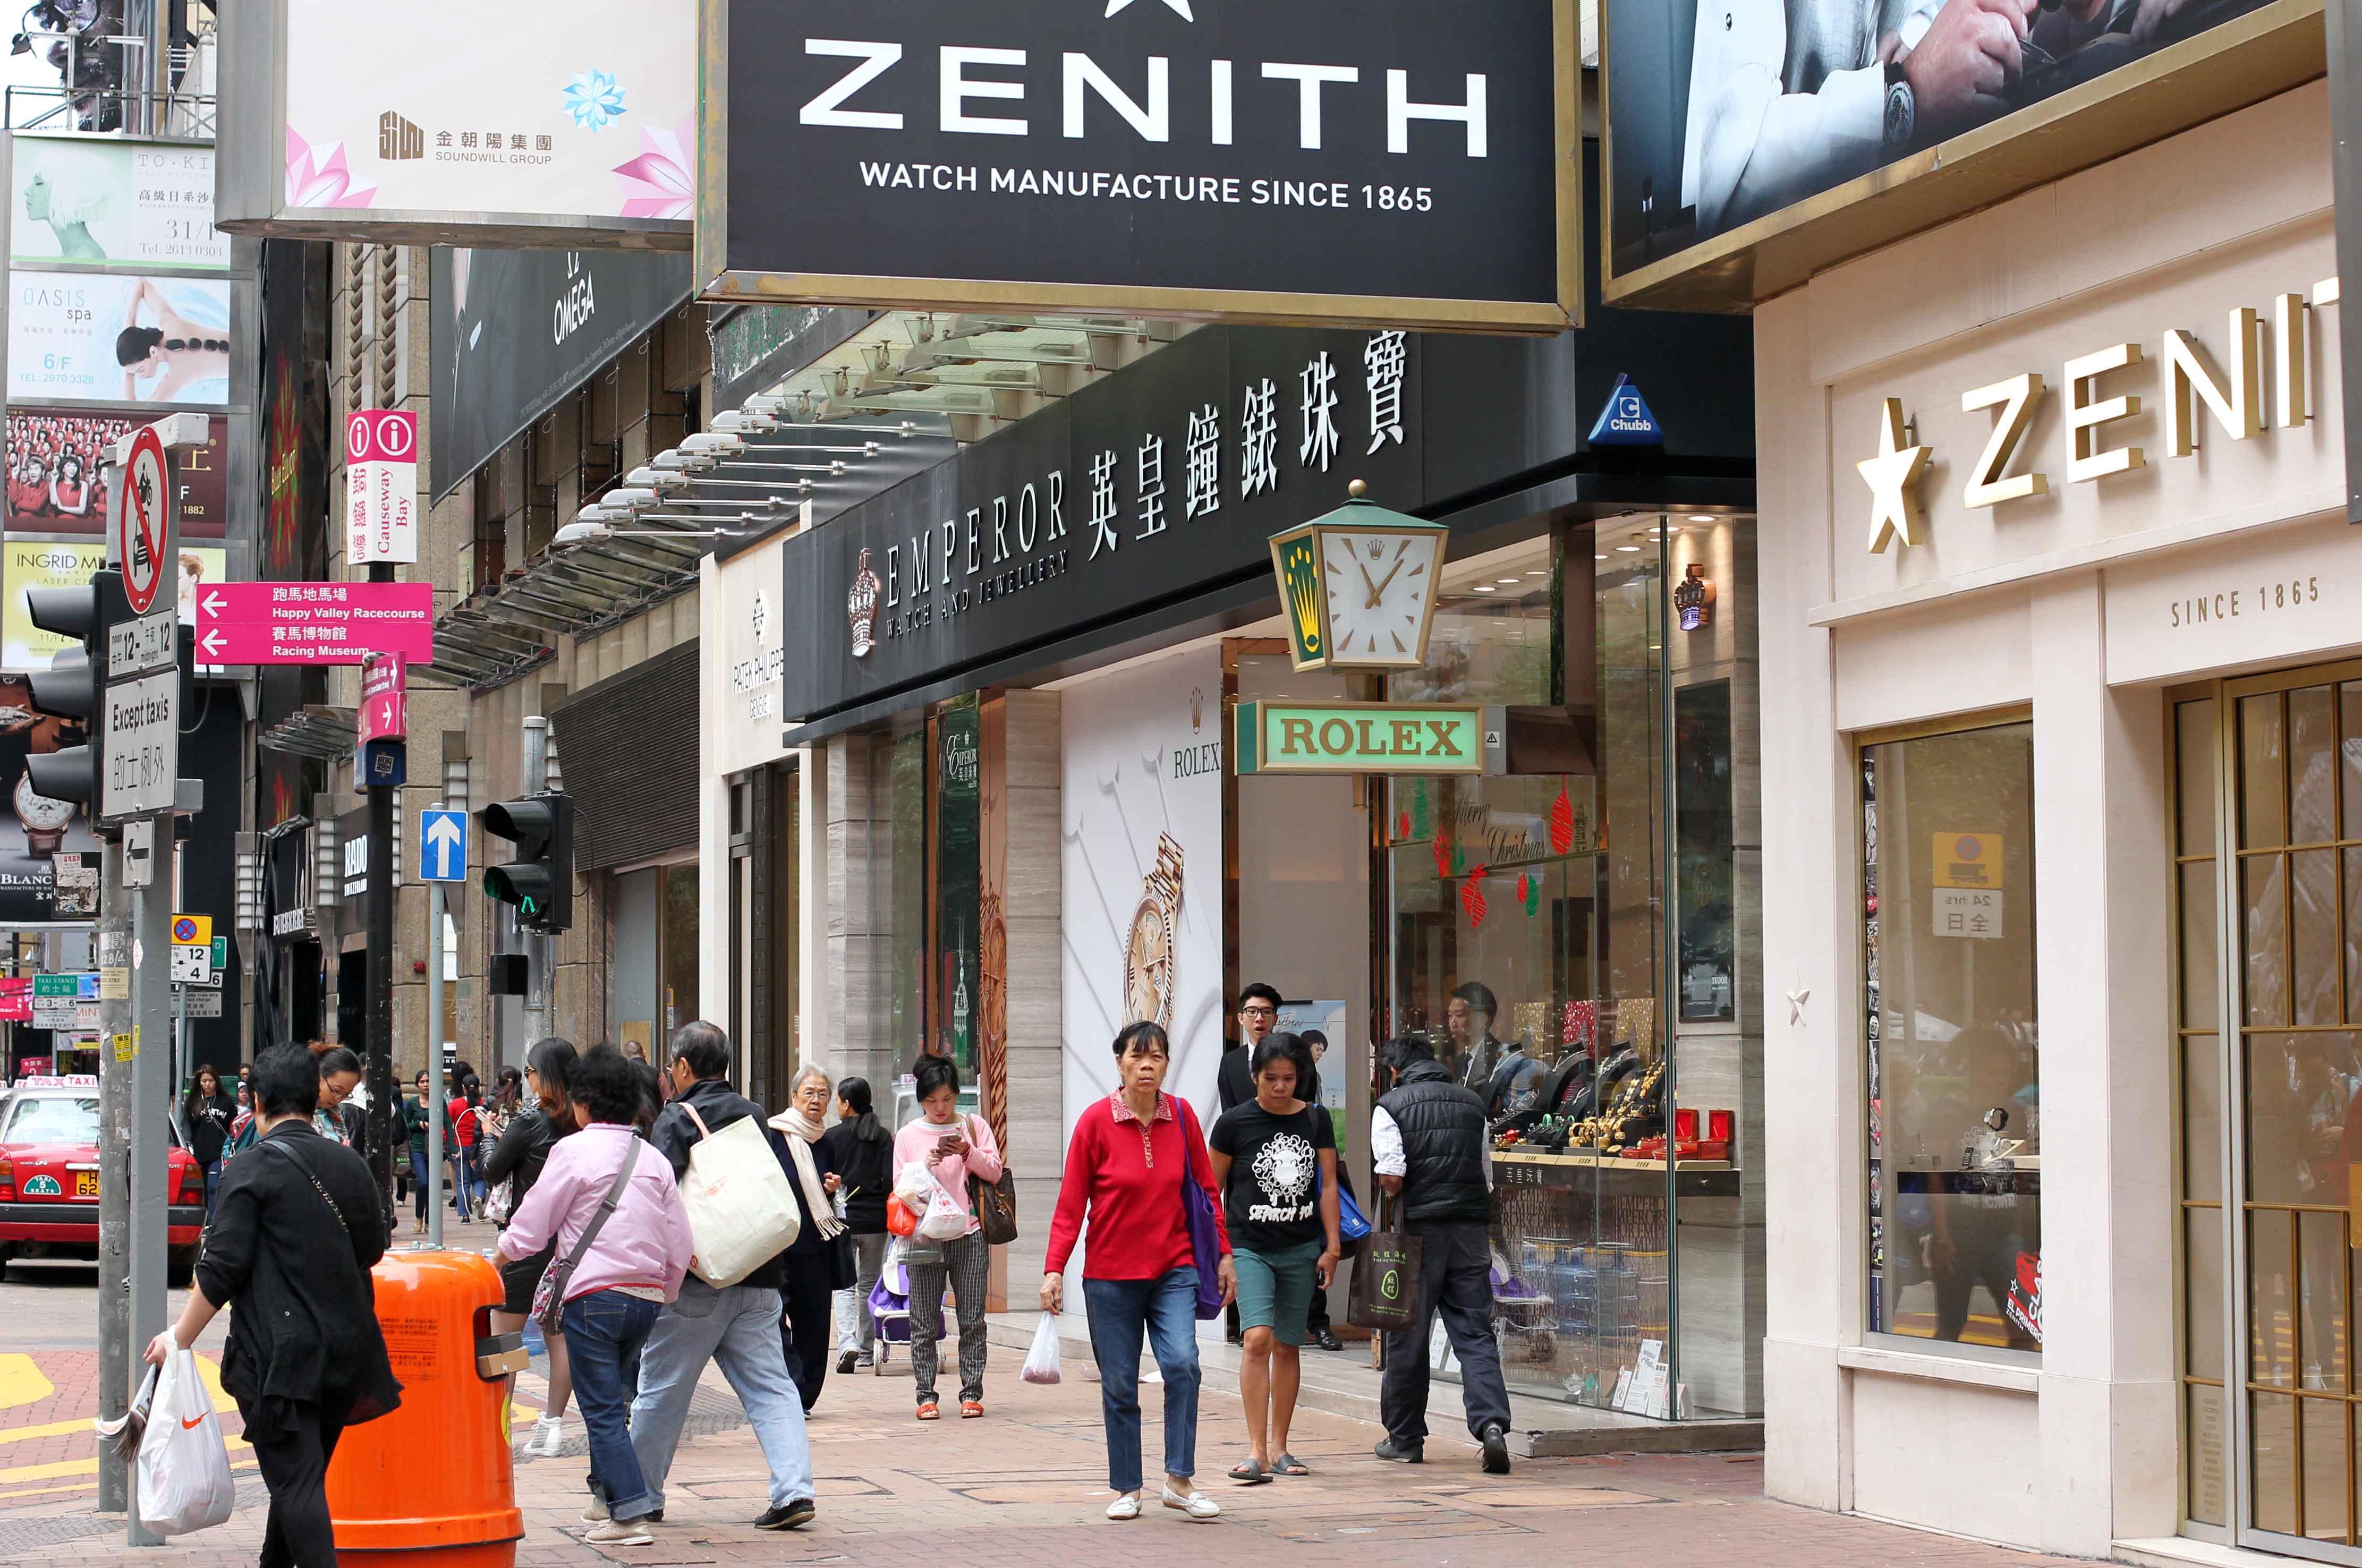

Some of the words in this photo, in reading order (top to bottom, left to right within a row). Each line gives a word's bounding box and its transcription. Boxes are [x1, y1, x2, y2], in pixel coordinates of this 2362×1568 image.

[800, 38, 1486, 158] ZENITH
[436, 131, 552, 150] 金朝陽集團
[436, 152, 505, 163] SOUNDWILL
[510, 155, 551, 164] GROUP
[139, 189, 215, 203] 高級日系沙
[859, 161, 978, 193] WATCH
[990, 168, 1241, 204] MANUFACTURE
[1251, 180, 1349, 209] SINCE
[1361, 184, 1433, 212] 1865
[67, 309, 92, 323] spa
[554, 270, 595, 346] OMEGA
[44, 354, 71, 369] 6/F
[43, 374, 67, 383] 2970
[70, 375, 94, 384] 3328
[1610, 419, 1652, 431] Chubb
[1088, 330, 1407, 561] 英皇鐘錶珠寶
[353, 467, 367, 560] 銅鑼灣
[378, 467, 393, 553] Causeway
[396, 496, 411, 527] Bay
[887, 470, 1067, 608] EMPEROR
[16, 554, 77, 569] INGRID
[273, 587, 347, 602] 跑馬地馬場
[887, 603, 931, 638] WATCH
[941, 588, 970, 619] AND
[978, 550, 1067, 604] JEWELLERY
[2171, 590, 2239, 628] SINCE
[2259, 577, 2318, 610] 1865
[273, 608, 311, 620] Happy
[315, 608, 351, 620] Valley
[354, 608, 426, 618] Racecourse
[160, 621, 171, 653] 12
[272, 626, 347, 641] 賽馬博物館
[273, 645, 315, 658] Racing
[318, 645, 369, 656] Museum
[734, 659, 753, 693] PATEK
[754, 647, 784, 686] PHILIPPE
[113, 698, 145, 734] Except
[146, 692, 168, 728] taxis
[749, 694, 767, 719] GENEVE
[1280, 718, 1463, 756] ROLEX
[114, 743, 165, 791] 的士例外
[1174, 743, 1220, 779] ROLEX
[1454, 796, 1490, 836] Merry
[344, 834, 368, 877] RADO
[1487, 826, 1548, 866] Christmas
[273, 907, 305, 936] BURBERRY
[189, 948, 204, 960] 12
[190, 967, 201, 979] 4
[213, 975, 220, 985] 6
[1712, 976, 1727, 985] TUDOR
[68, 1077, 96, 1086] TAXI
[1248, 1204, 1297, 1223] SEARCH
[2006, 1308, 2024, 1331] ZENITH
[2007, 1297, 2015, 1313] EL
[2015, 1308, 2043, 1343] PRIMERO
